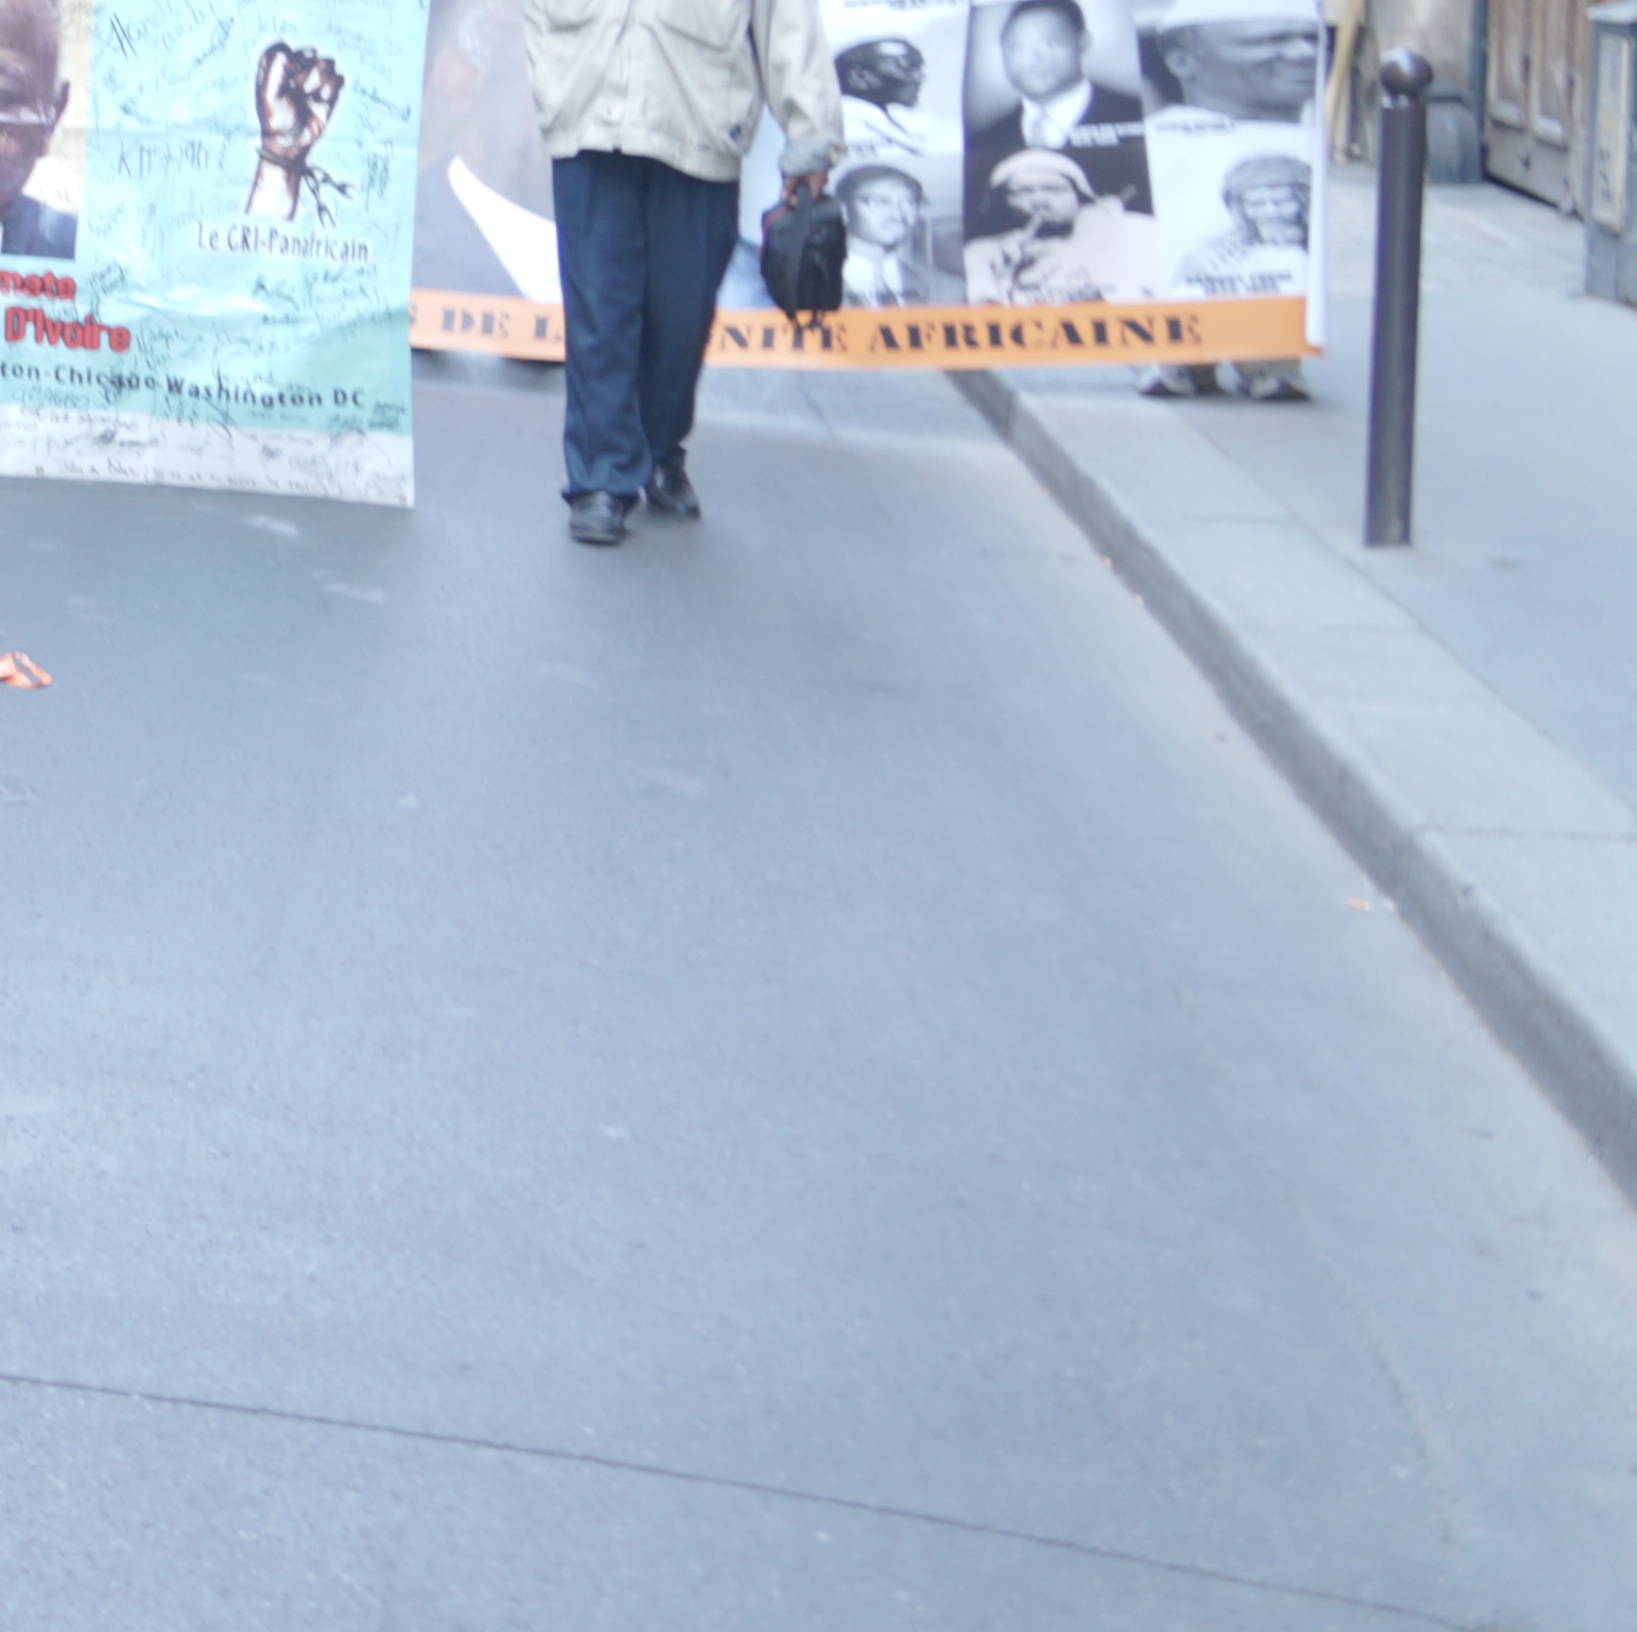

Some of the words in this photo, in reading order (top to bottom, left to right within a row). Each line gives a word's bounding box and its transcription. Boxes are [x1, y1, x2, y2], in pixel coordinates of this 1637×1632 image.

[198, 223, 221, 252] Le
[6, 306, 133, 354] D'Ivoire
[441, 305, 512, 340] DE
[870, 313, 1203, 353] AFRICAINE
[333, 385, 366, 409] DC
